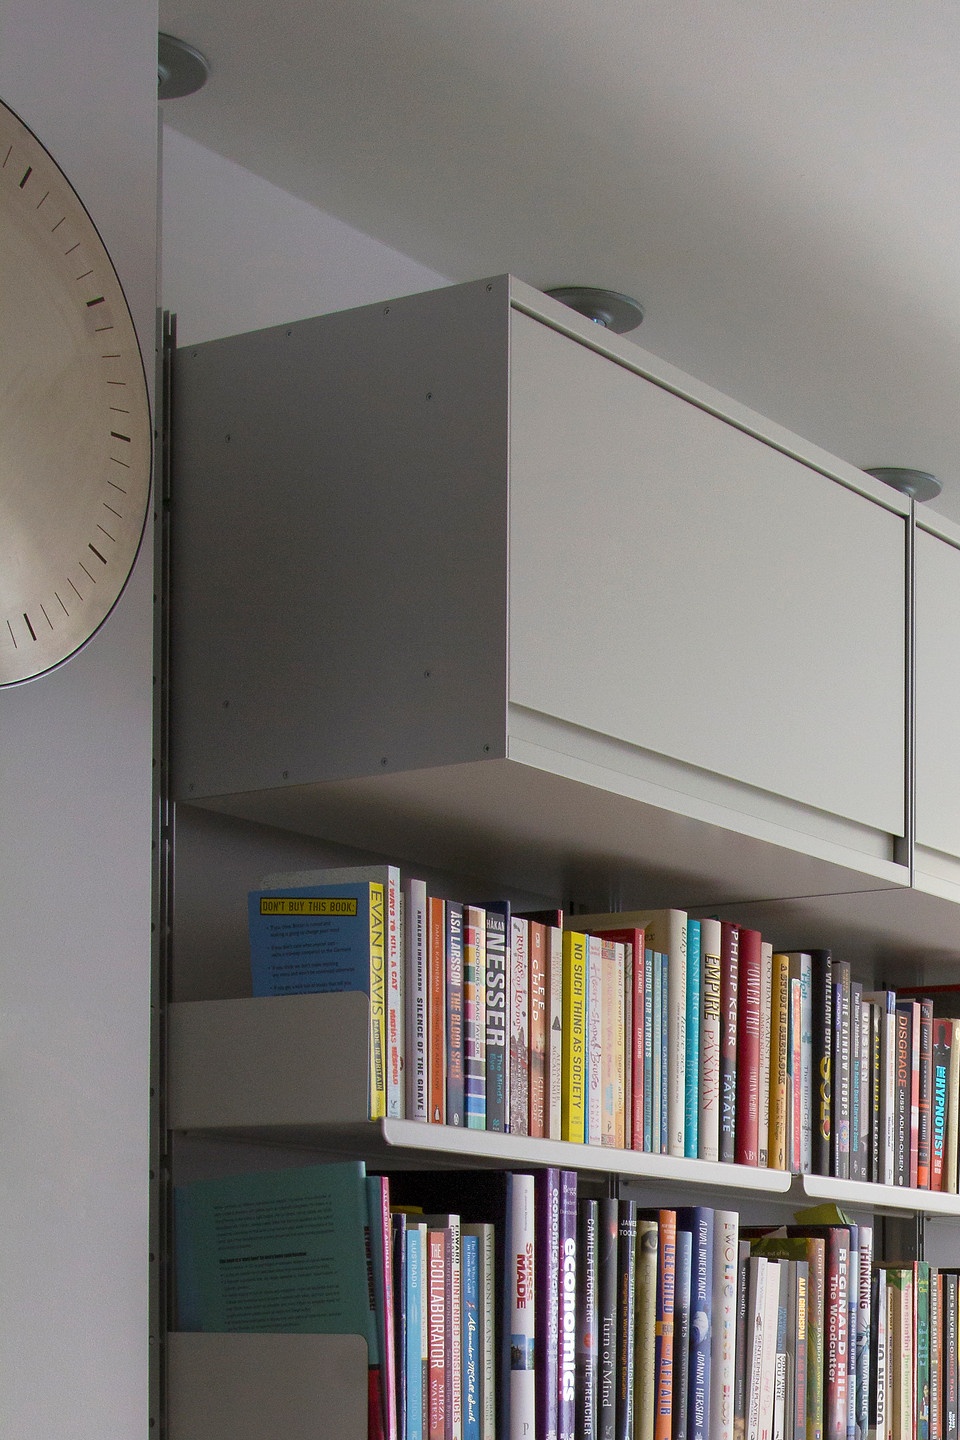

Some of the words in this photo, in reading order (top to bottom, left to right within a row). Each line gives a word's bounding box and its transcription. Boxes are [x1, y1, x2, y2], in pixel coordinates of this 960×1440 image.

[263, 902, 284, 911] DON'T
[289, 902, 304, 911] BUY
[309, 902, 326, 912] THIS
[371, 890, 383, 948] EVAN
[390, 920, 396, 931] TO
[450, 911, 463, 933] ÅSA
[450, 936, 461, 986] LARSSON
[574, 943, 583, 961] NO
[730, 931, 739, 994] PHILIP
[372, 955, 383, 1016] DAVIS
[486, 931, 505, 1046] NESSER
[573, 965, 582, 998] SUCH
[704, 954, 720, 1020] EMPIRE
[416, 998, 424, 1038] SILENCE
[573, 1001, 582, 1034] THING
[728, 997, 737, 1046] KERR
[417, 1042, 424, 1053] OF
[573, 1037, 582, 1054] AS
[898, 1015, 908, 1087] DISGRACE
[417, 1078, 425, 1111] GRAVE
[573, 1057, 582, 1109] SOCIETY
[703, 1029, 714, 1112] PAXMAN
[723, 1074, 731, 1132] FATALE
[934, 1077, 944, 1158] HYPNOTIST
[587, 1219, 595, 1265] CAMILLA
[664, 1244, 674, 1268] LEE
[517, 1254, 526, 1309] MADE
[664, 1273, 674, 1313] CHILD
[698, 1248, 706, 1300] INHERITANCE
[830, 1274, 838, 1299] The
[860, 1245, 869, 1309] THINKING
[431, 1260, 444, 1368] COLLABORATOR
[453, 1270, 461, 1337] UNINTENDED
[562, 1238, 575, 1401] economics
[797, 1299, 805, 1339] GREENSPAN
[838, 1248, 847, 1355] REGINALD
[603, 1316, 612, 1347] Turn
[829, 1304, 837, 1382] Woodcutter
[453, 1341, 461, 1423] CONSEQUENCES
[585, 1358, 593, 1378] THE
[603, 1352, 612, 1364] of
[696, 1351, 705, 1384] JOANNA
[584, 1382, 593, 1435] PREACHER
[602, 1369, 612, 1407] Mind
[661, 1359, 671, 1415] AFFAIR
[696, 1387, 705, 1427] HERSHON
[837, 1363, 845, 1409] HILL
